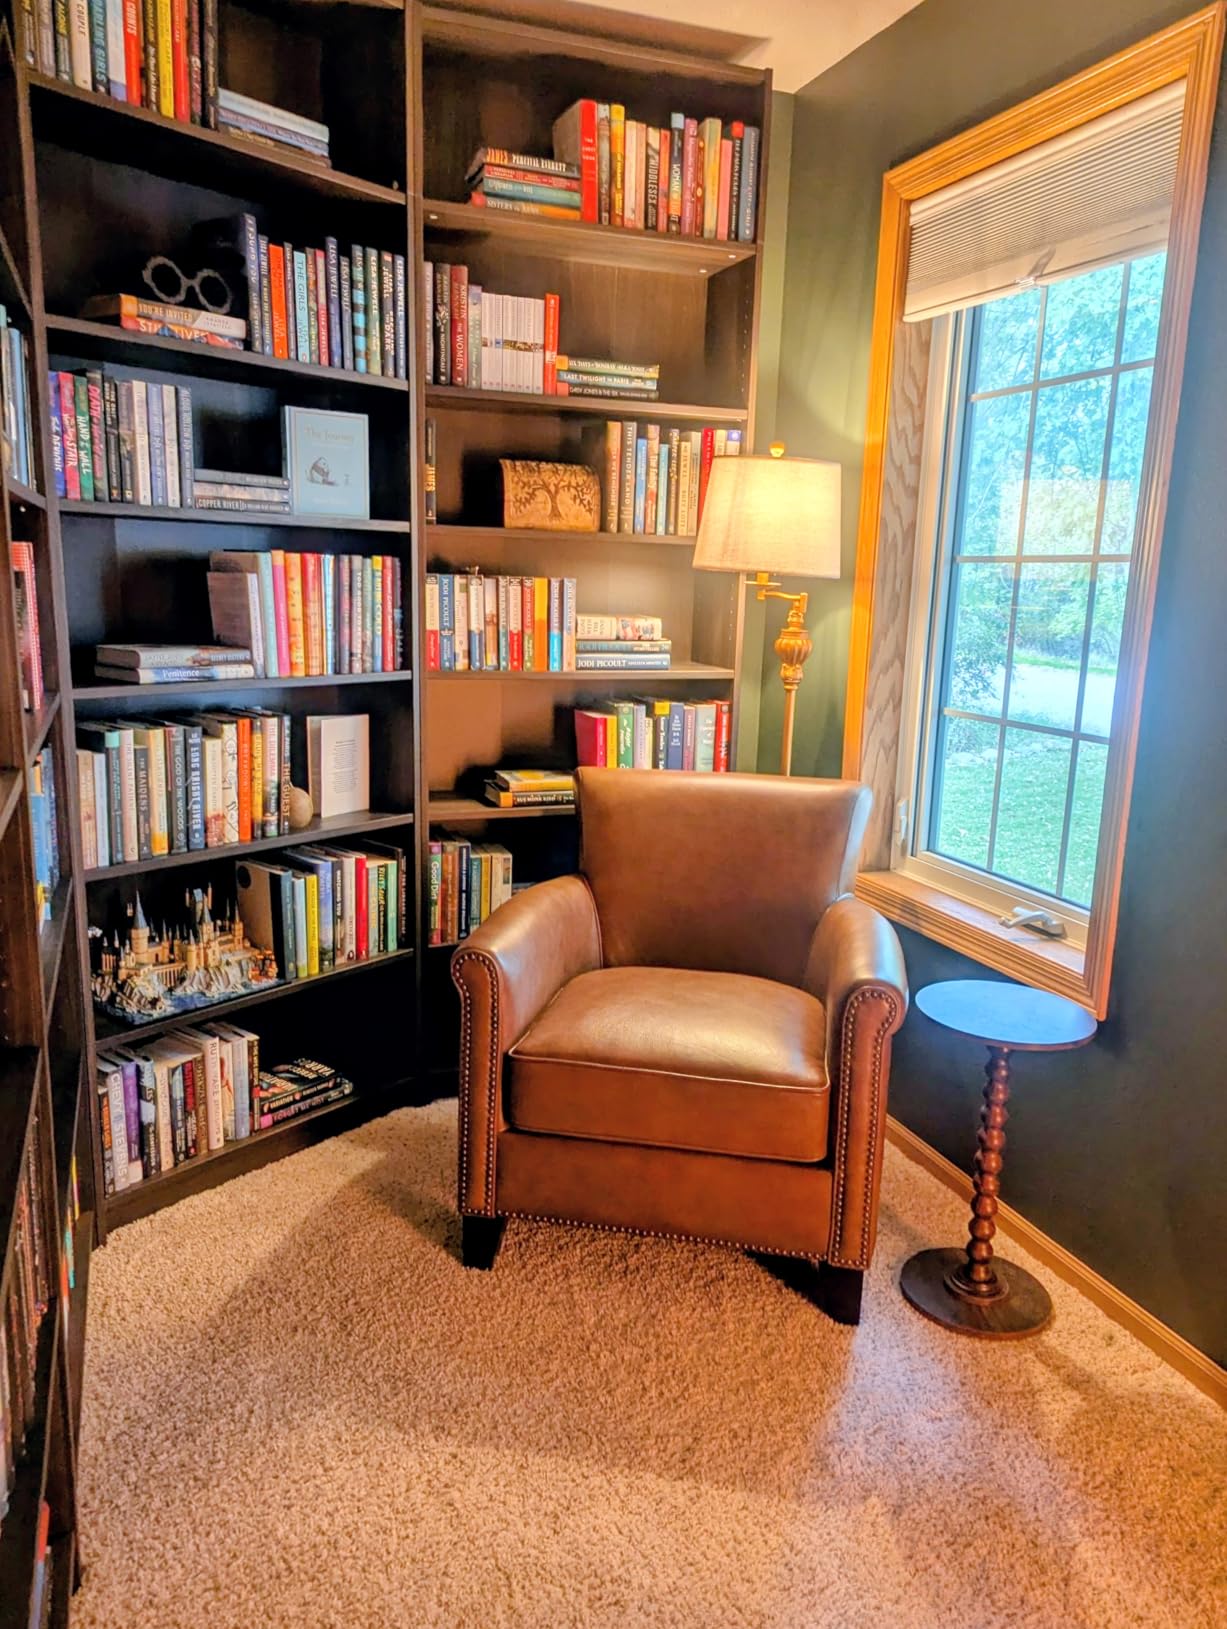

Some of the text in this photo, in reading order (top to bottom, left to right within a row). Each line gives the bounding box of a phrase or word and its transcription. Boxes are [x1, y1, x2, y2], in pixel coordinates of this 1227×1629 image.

[77, 4, 86, 36] COUPLE
[127, 2, 138, 37] COUNTS
[96, 48, 107, 83] GIRLS
[648, 158, 659, 205] MIDDLESEX
[672, 163, 681, 192] WOMAN
[296, 261, 306, 313] THE GIRLS
[329, 244, 339, 299] LISA JEWELL
[341, 261, 351, 313] LISA JEWELL
[382, 265, 390, 299] JEWELL
[396, 259, 405, 318] LISA JEWELL
[138, 303, 194, 323] YOU'RE INVITED
[384, 323, 392, 352] DARK
[455, 334, 464, 371] WOMEN
[564, 373, 629, 385] LAST TWILIGHT PARIS
[88, 384, 101, 417] DEATH
[66, 441, 77, 468] STAIR
[77, 415, 90, 475] HAND WALL
[625, 448, 633, 480] TENDER
[197, 497, 222, 509] COPPER
[624, 481, 632, 505] LAND
[441, 578, 450, 627] JODI PICOULT
[552, 582, 560, 627] JODI PICOULT
[566, 582, 575, 598] JODI
[162, 668, 200, 679] Penitence
[577, 659, 627, 668] JODI PICOULT
[139, 770, 147, 811] MAIDENS
[176, 777, 182, 786] OF
[191, 747, 201, 830] LONG BRIGHT RIVER
[282, 784, 290, 817] GUEST
[431, 861, 440, 900] Good Dirt
[110, 1072, 127, 1177] CHEVY STEVENS
